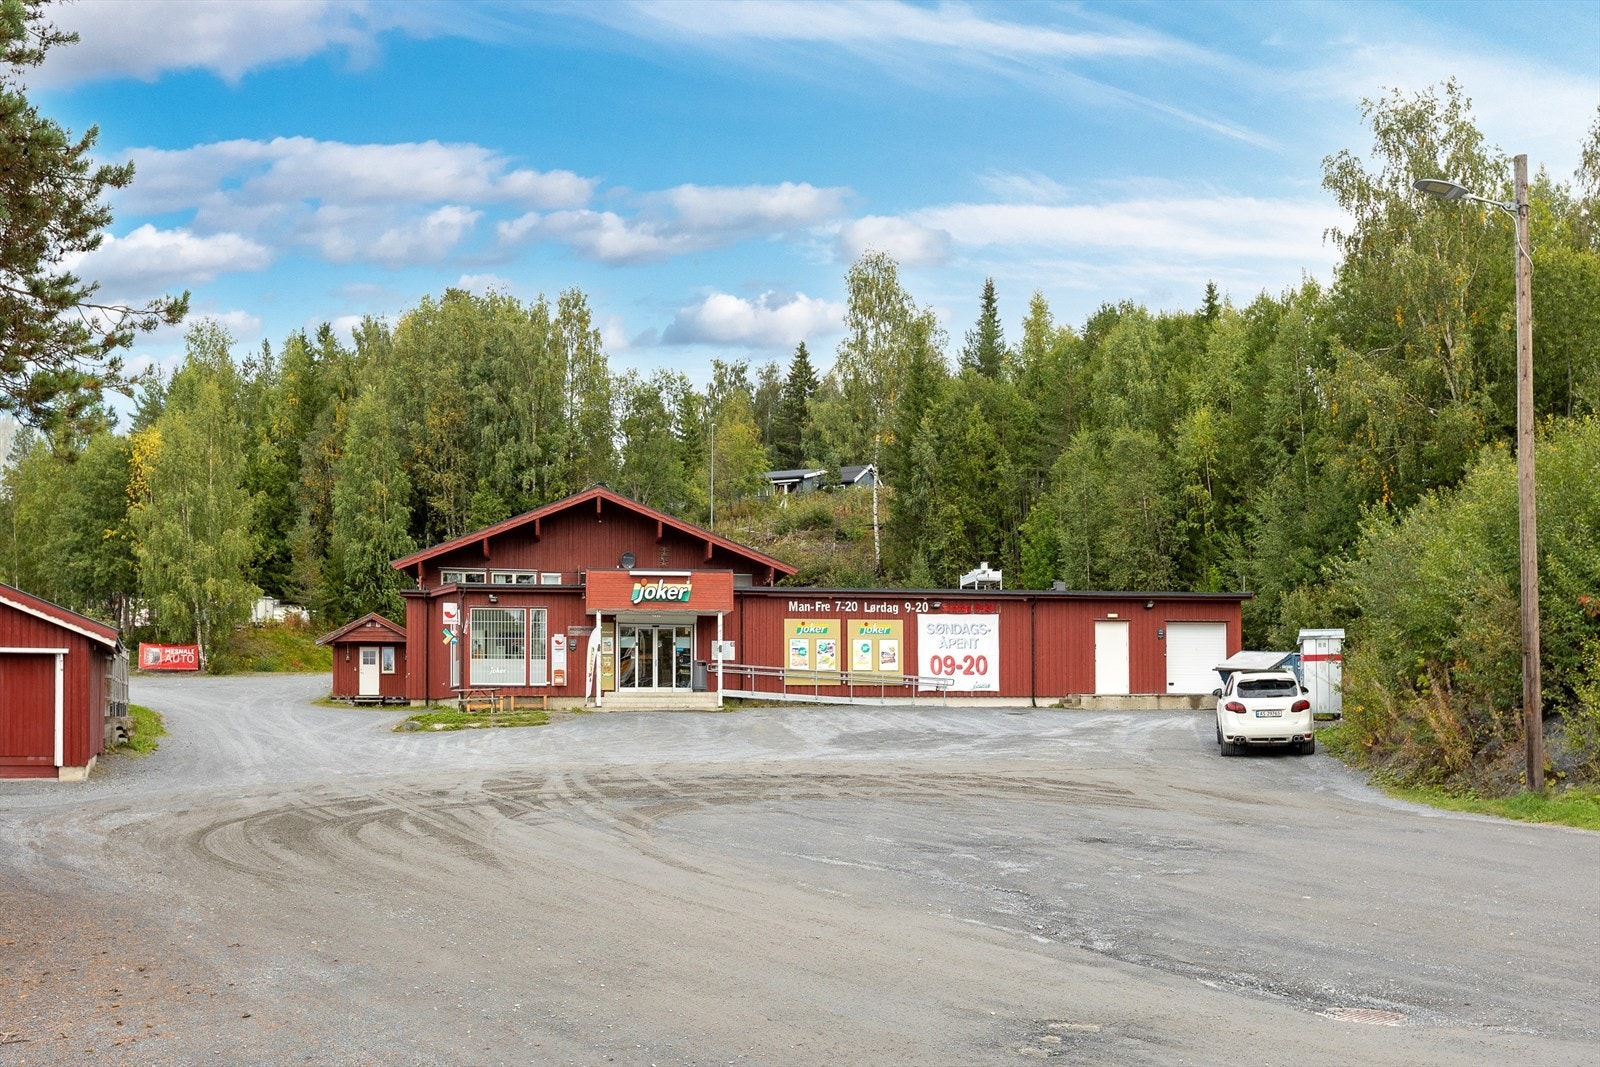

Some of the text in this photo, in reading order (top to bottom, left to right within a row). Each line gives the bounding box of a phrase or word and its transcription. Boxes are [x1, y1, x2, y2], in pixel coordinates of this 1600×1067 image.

[633, 578, 688, 604] joker
[788, 601, 831, 612] Man-Fre
[835, 601, 858, 612] 7-20
[864, 602, 899, 615] Lørdag
[904, 602, 929, 613] 9-20
[798, 621, 827, 635] joker
[860, 622, 890, 636] joker
[927, 624, 991, 635] SØNDAGS-
[939, 636, 979, 649] ÅPENT
[165, 654, 195, 663] AUTO
[930, 655, 988, 675] 09-20
